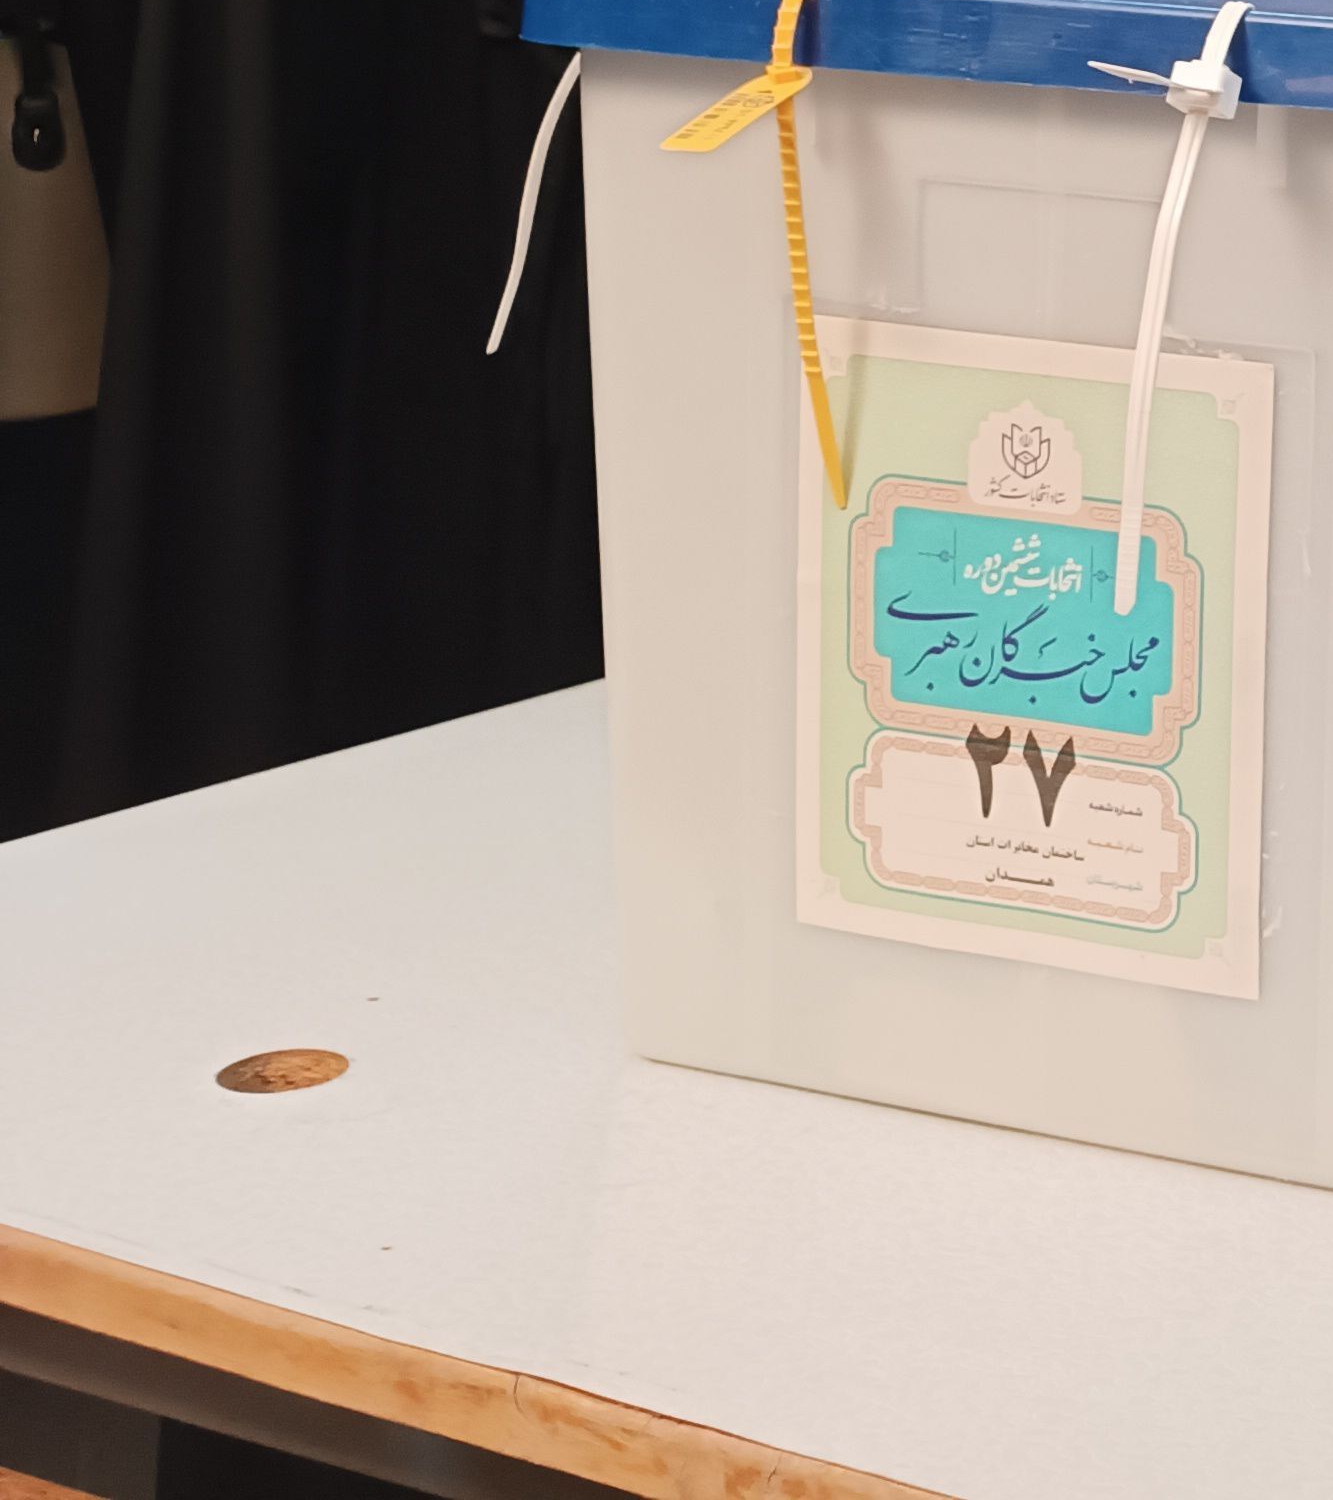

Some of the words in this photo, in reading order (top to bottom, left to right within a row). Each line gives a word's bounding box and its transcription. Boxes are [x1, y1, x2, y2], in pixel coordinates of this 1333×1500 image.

[963, 553, 1002, 579] دوره
[981, 533, 1042, 597] ششمین
[1013, 557, 1083, 601] انتخابات
[886, 590, 980, 692] رهبری
[958, 601, 1106, 705] خبرگان
[1079, 635, 1160, 705] مجلس
[965, 723, 1077, 828] ۲۷
[985, 867, 1055, 888] همدان
